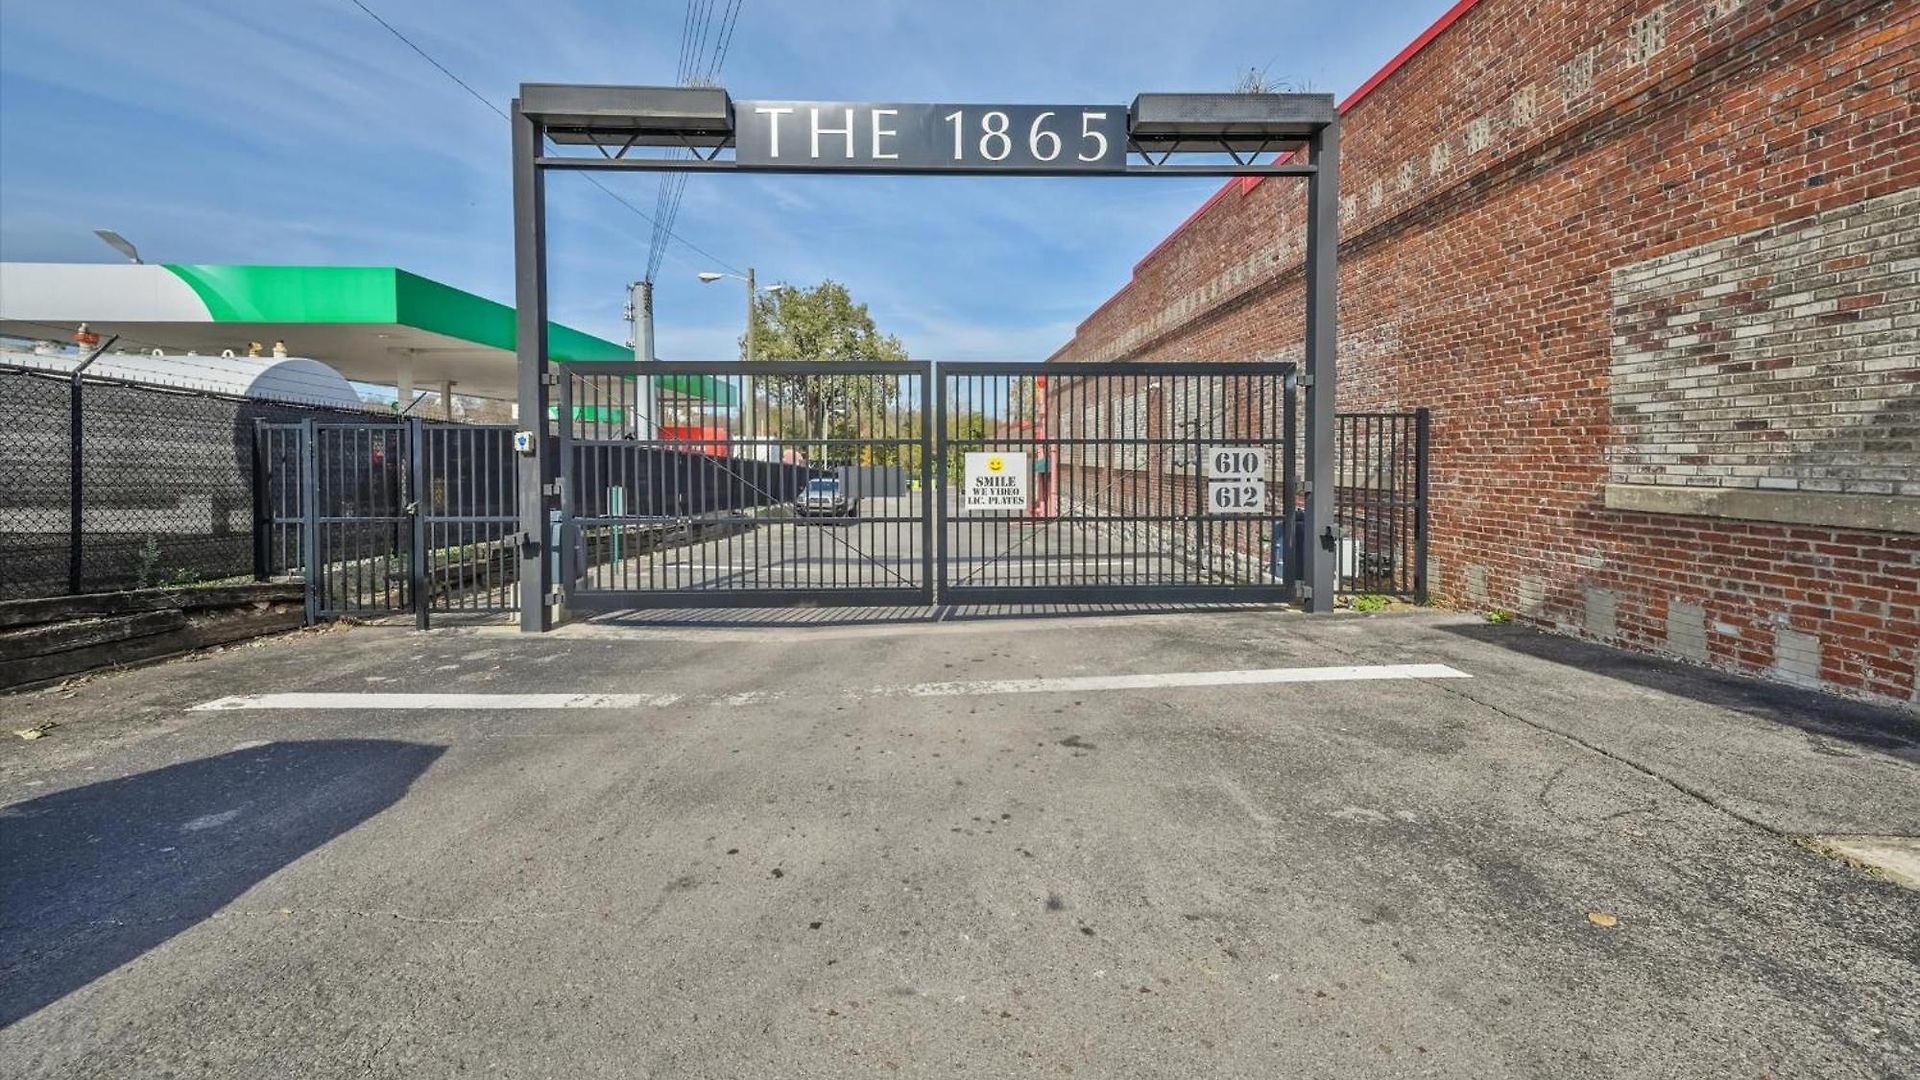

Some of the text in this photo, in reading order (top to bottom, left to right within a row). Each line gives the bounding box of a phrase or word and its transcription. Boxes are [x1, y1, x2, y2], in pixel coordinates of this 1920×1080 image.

[754, 106, 1109, 162] THE 1865
[1215, 452, 1259, 474] 610
[976, 476, 1016, 487] SMILE
[973, 488, 1020, 496] WE VIDEO
[1215, 486, 1258, 508] 612
[968, 497, 1025, 505] LIC. PLATES
